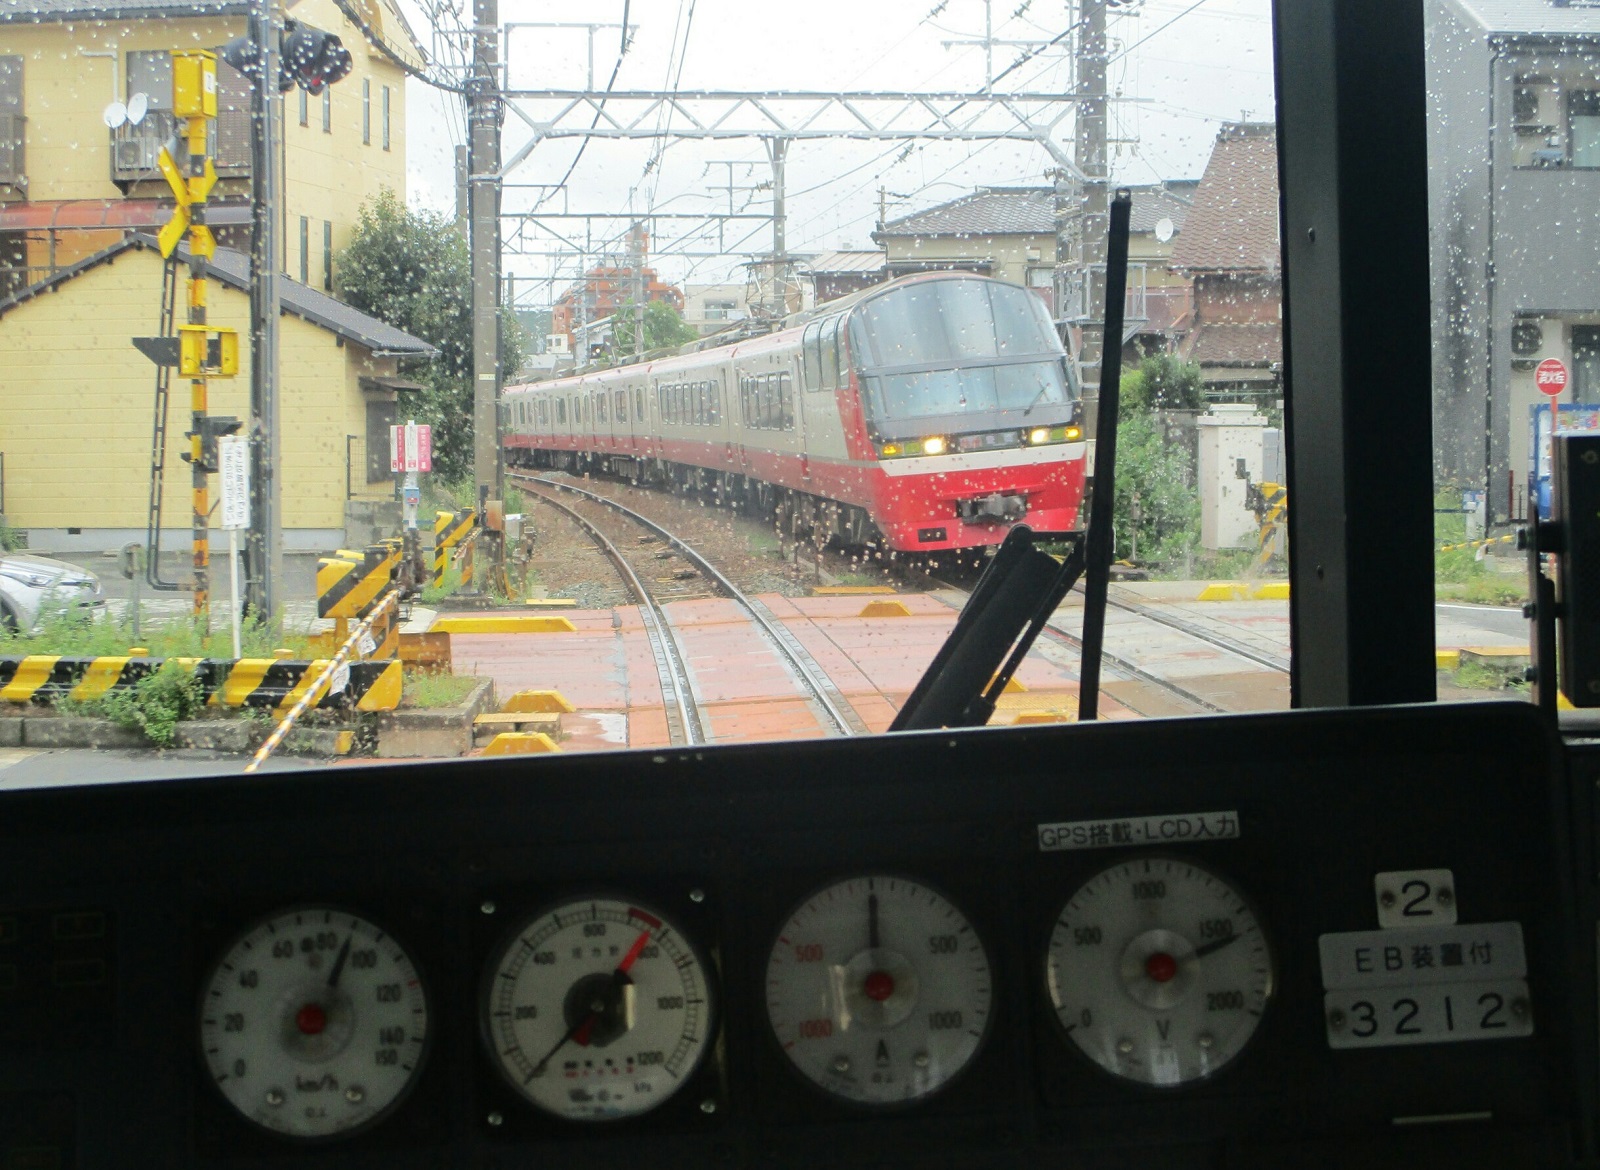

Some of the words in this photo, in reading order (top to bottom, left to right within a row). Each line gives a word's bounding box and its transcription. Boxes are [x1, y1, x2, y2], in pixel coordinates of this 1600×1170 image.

[1132, 880, 1166, 900] 1000
[1402, 880, 1432, 916] 2
[583, 923, 607, 938] 600
[1073, 925, 1102, 946] 500
[1198, 918, 1233, 939] 1500
[272, 940, 293, 958] 60
[317, 931, 337, 951] 80
[929, 935, 958, 954] 500
[352, 948, 377, 969] 100
[533, 951, 556, 965] 400
[795, 943, 823, 963] 500
[239, 969, 258, 989] 40
[377, 983, 402, 1002] 120
[656, 995, 684, 1010] 1000
[1207, 990, 1243, 1012] 2000
[224, 1012, 244, 1033] 20
[515, 1005, 537, 1020] 200
[928, 1010, 963, 1030] 1000
[1082, 1008, 1092, 1028] 0
[1350, 992, 1507, 1037] 3212
[379, 1026, 405, 1045] 140
[799, 1019, 833, 1039] 1000
[1155, 1019, 1170, 1041] V
[375, 1048, 398, 1065] 150
[637, 1051, 664, 1066] 1200
[876, 1038, 889, 1060] A
[235, 1058, 246, 1077] 0
